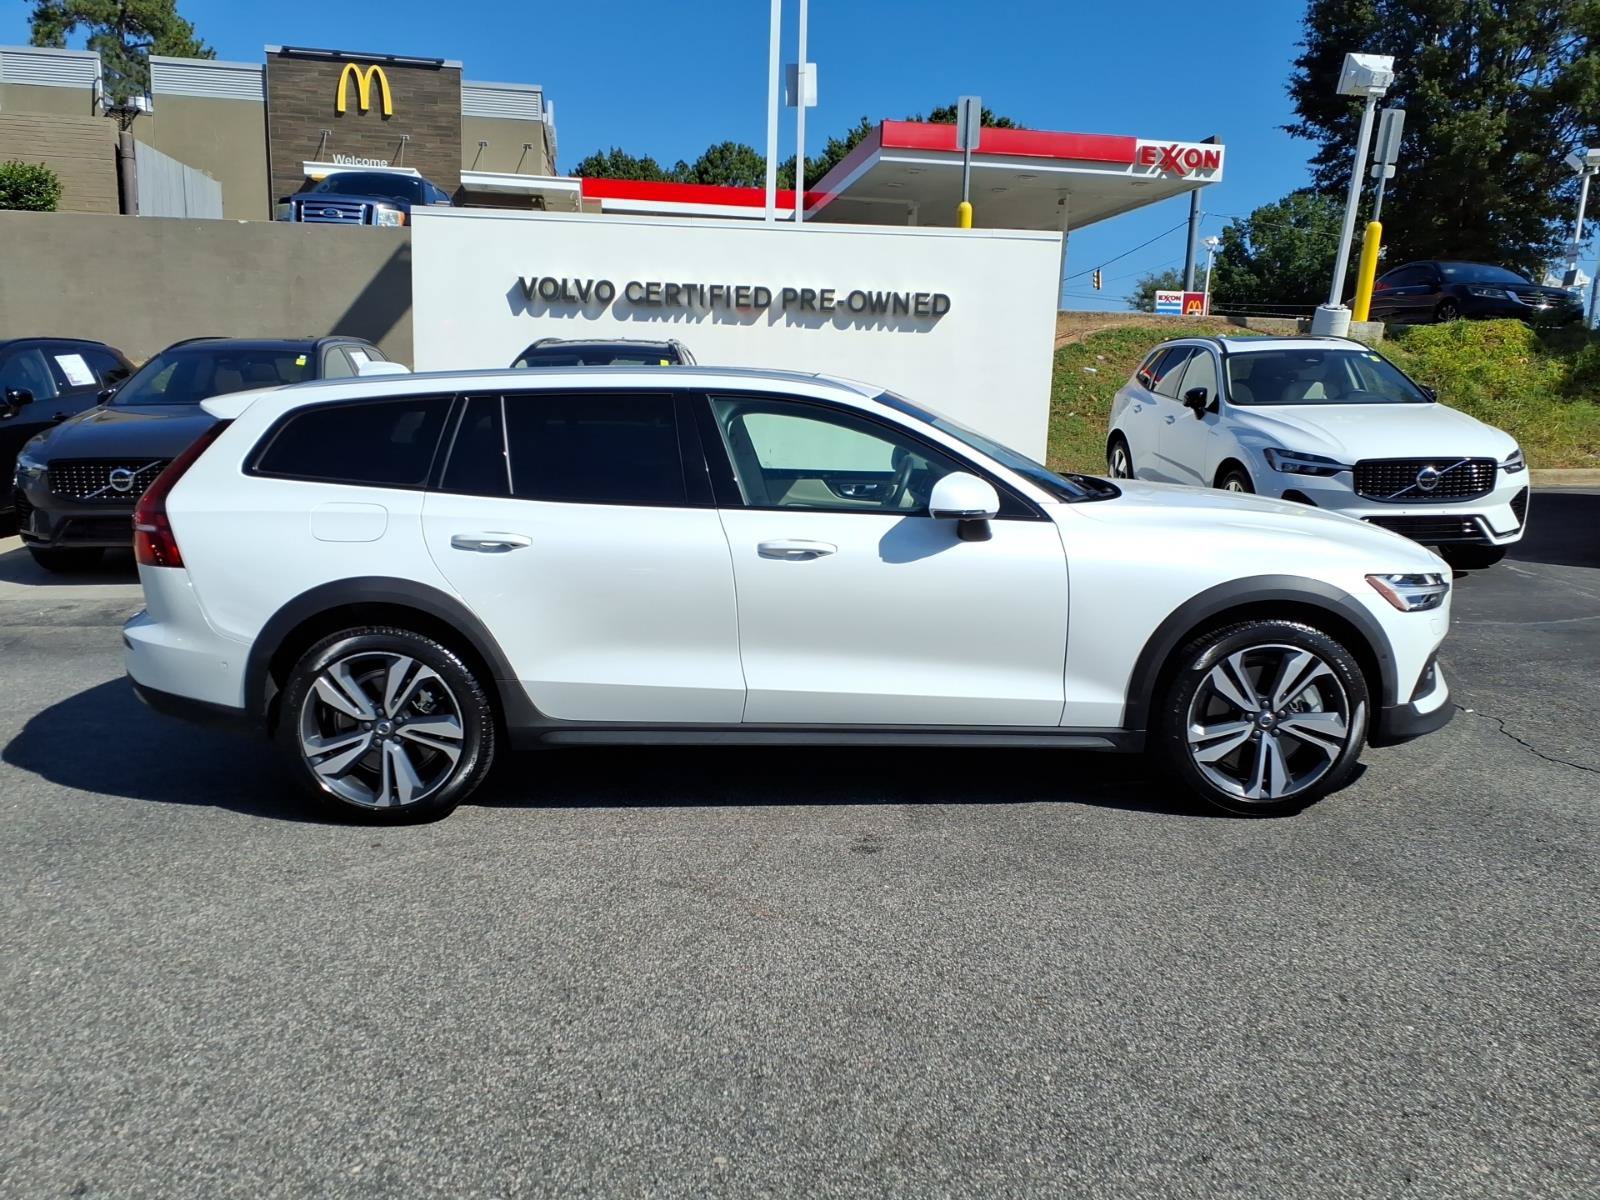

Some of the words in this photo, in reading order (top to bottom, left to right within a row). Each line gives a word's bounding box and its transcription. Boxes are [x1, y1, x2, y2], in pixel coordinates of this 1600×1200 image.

[333, 154, 388, 167] Welcome
[1140, 144, 1221, 175] EXXON
[519, 276, 616, 304] VOLVO
[624, 280, 772, 309] CERTIFIED
[782, 287, 950, 316] PRE-OWNED
[1158, 294, 1181, 303] EXXON
